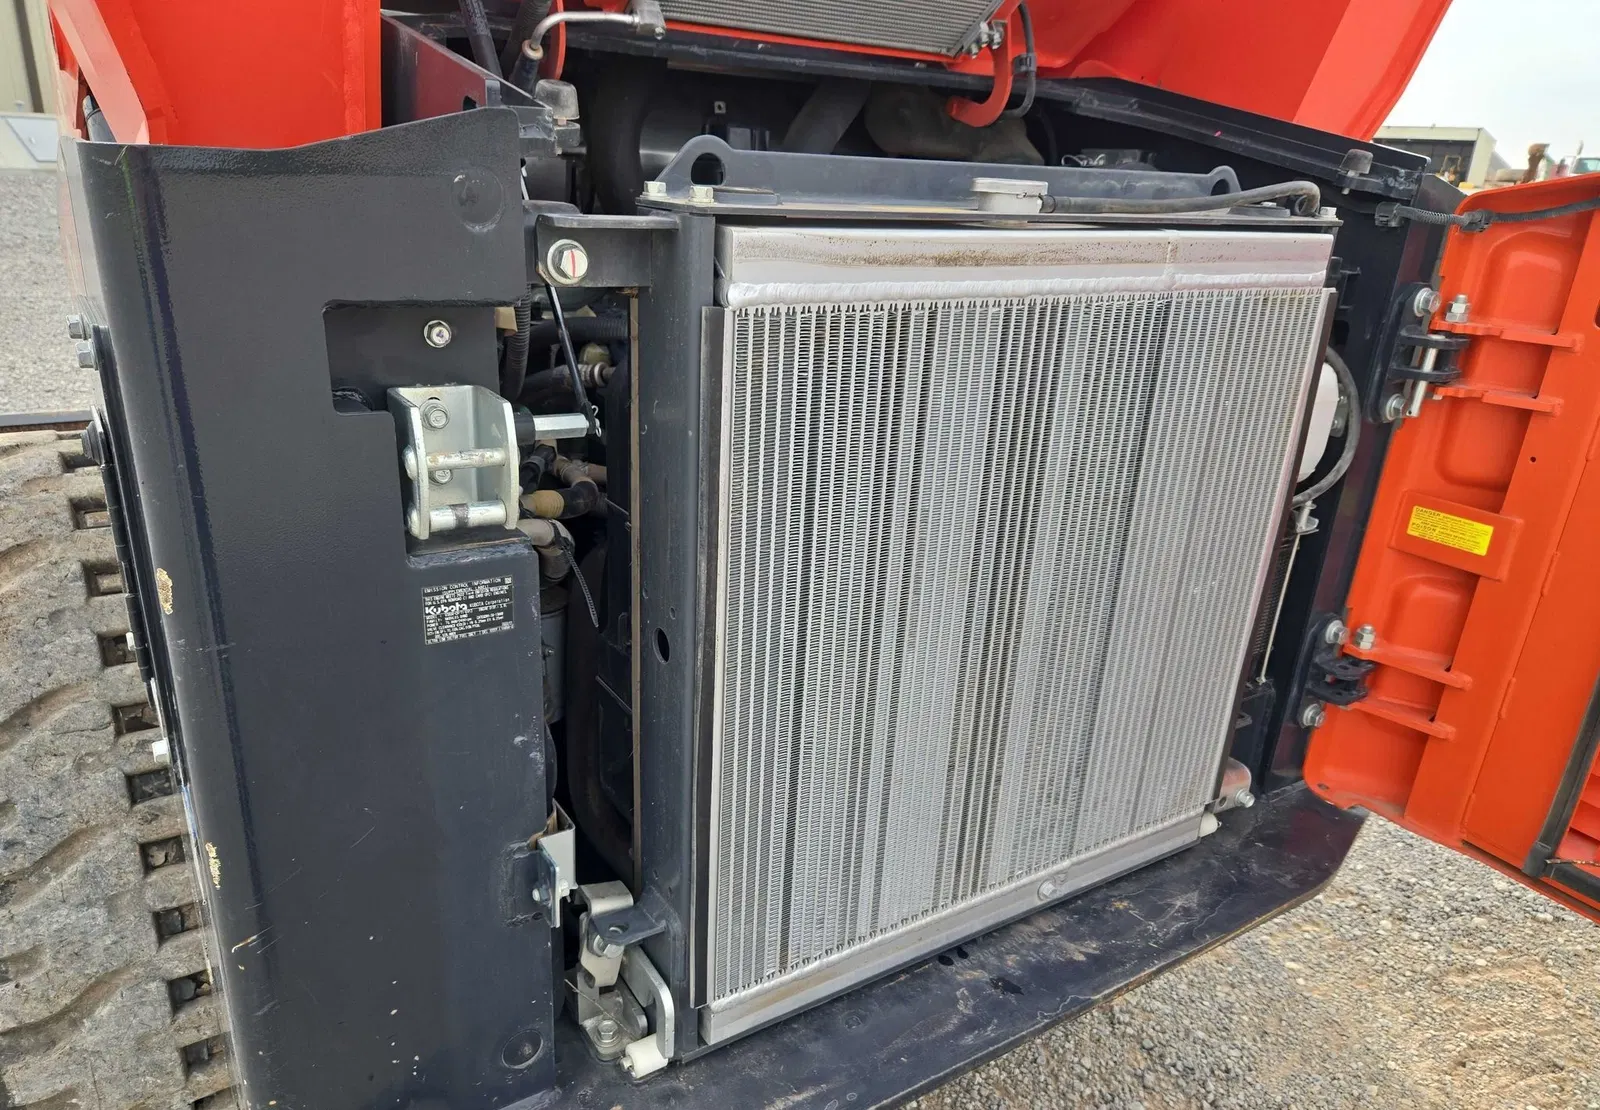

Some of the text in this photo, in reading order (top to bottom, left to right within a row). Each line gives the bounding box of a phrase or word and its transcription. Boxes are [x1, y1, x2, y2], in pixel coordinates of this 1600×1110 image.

[1416, 508, 1441, 516] DANGER
[1412, 522, 1436, 532] POISON
[425, 602, 467, 615] Kubota
